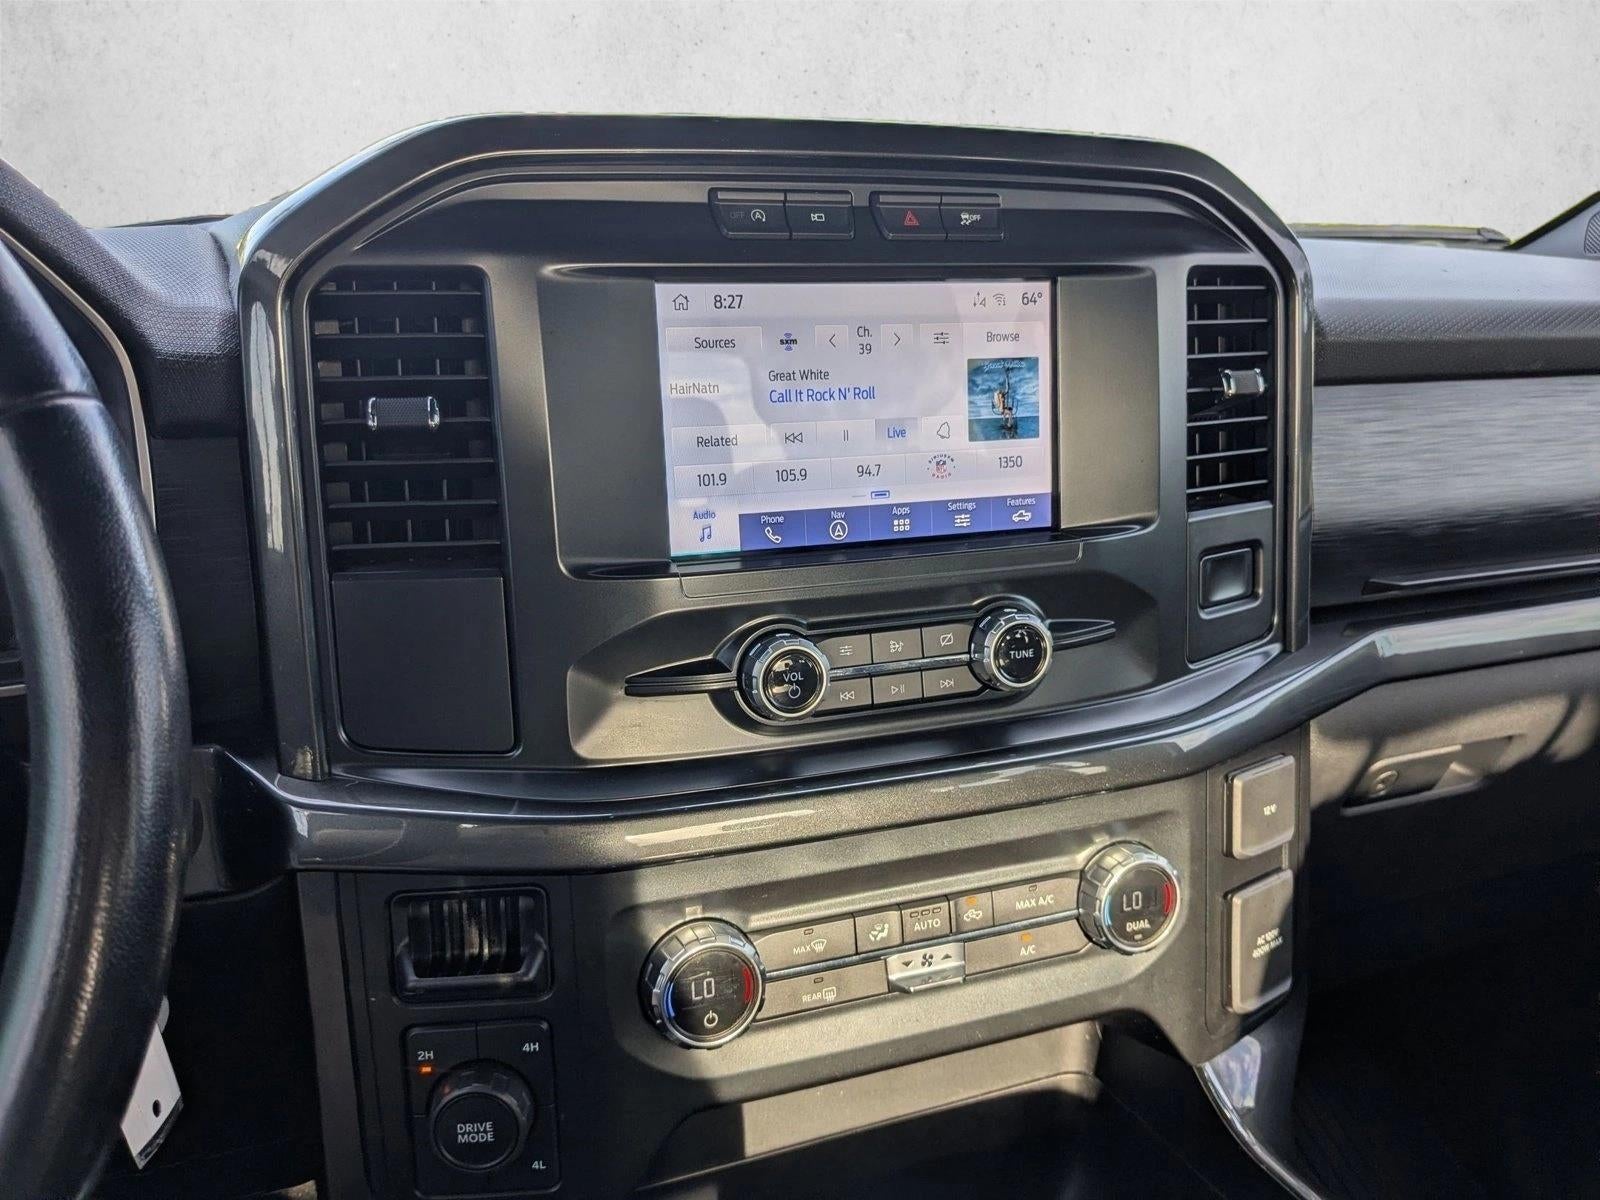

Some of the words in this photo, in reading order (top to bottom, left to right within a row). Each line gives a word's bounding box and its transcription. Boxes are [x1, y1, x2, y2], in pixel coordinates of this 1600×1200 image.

[713, 294, 743, 309] 8:27
[856, 325, 873, 338] Ch.
[986, 331, 1020, 343] Browse
[694, 336, 736, 349] Sources
[858, 343, 872, 355] 39
[768, 369, 796, 382] Great
[799, 369, 830, 381] White
[669, 382, 720, 395] HairNatn
[769, 389, 793, 403] Call
[795, 389, 805, 402] It
[807, 388, 835, 402] Rock
[838, 387, 851, 400] N'
[853, 387, 876, 400] Roll
[887, 426, 906, 439] Live
[696, 434, 738, 448] Related
[998, 456, 1022, 468] 1350
[775, 468, 807, 482] 105.9
[856, 464, 881, 478] 94.7
[697, 472, 727, 487] 101.9
[947, 501, 976, 513] Settings
[1007, 496, 1036, 507] Features
[693, 510, 716, 520] Audio
[831, 510, 845, 520] Nav
[892, 505, 910, 517] Apps
[760, 514, 784, 524] Phone
[1010, 648, 1034, 660] TUNE
[782, 671, 804, 682] VOL
[1015, 897, 1037, 911] MAX
[1038, 893, 1054, 907] A/C
[914, 917, 941, 932] AUTO
[1126, 920, 1150, 932] DUAL
[793, 943, 811, 955] MAX
[1019, 944, 1036, 957] A/C
[802, 989, 822, 1002] REAR
[522, 1042, 539, 1052] 4H
[418, 1051, 434, 1060] 2H
[457, 1121, 493, 1133] DRIVE
[457, 1132, 495, 1143] MODE
[532, 1161, 546, 1169] 4L
